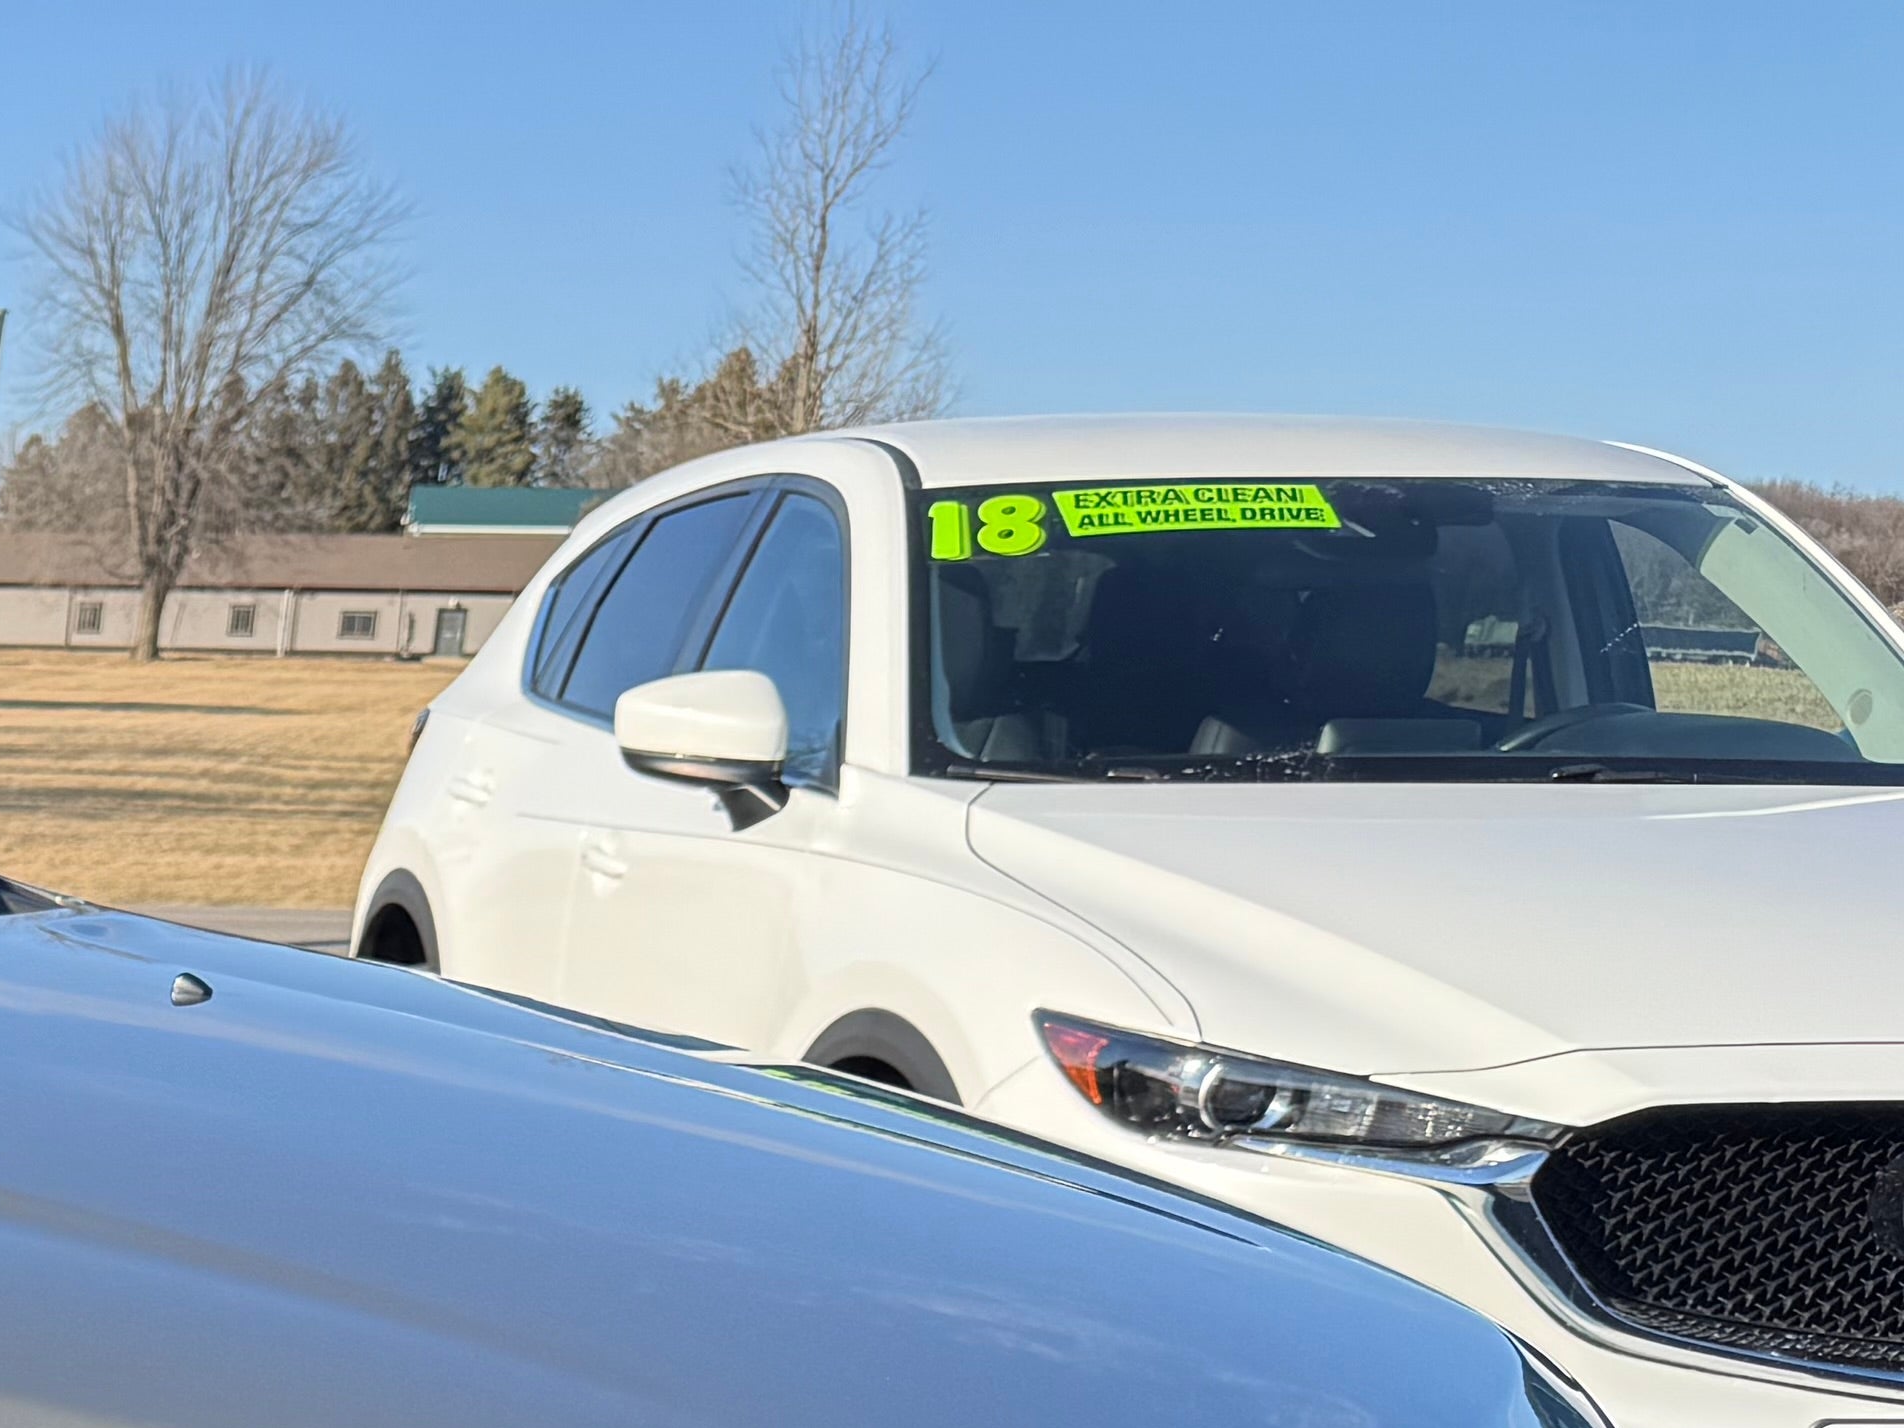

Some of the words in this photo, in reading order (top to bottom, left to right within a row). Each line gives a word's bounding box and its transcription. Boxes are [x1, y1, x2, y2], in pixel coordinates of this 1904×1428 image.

[1074, 488, 1190, 509] EXTRA
[1193, 487, 1304, 503] CLEAN
[928, 495, 1047, 561] 18
[1078, 512, 1134, 529] ALL
[1136, 508, 1236, 525] WHEEL
[1240, 506, 1326, 522] DRIVE
